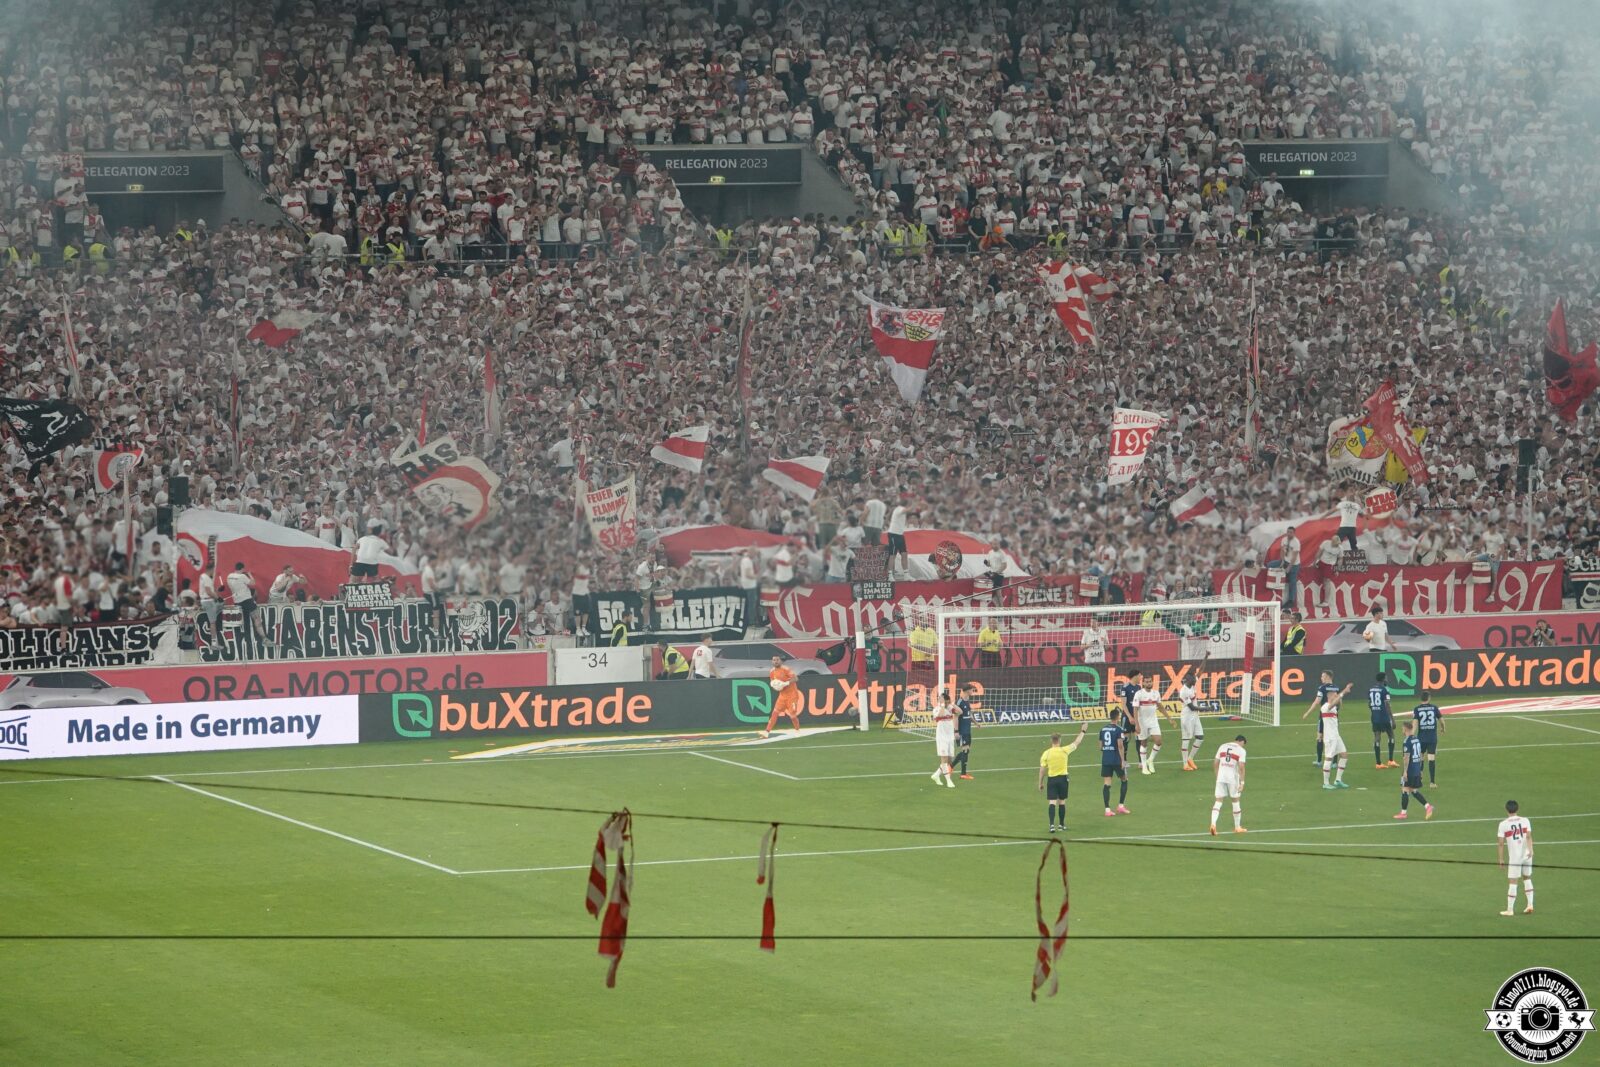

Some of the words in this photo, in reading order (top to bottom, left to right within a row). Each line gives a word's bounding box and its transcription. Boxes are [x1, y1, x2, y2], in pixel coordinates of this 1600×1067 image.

[665, 159, 737, 169] RELEGATION
[740, 158, 768, 168] 2023
[1260, 152, 1328, 162] RELEGATION
[1330, 151, 1357, 162] 2023
[84, 166, 158, 177] RELEGATION
[160, 165, 190, 176] 2023
[587, 489, 613, 504] FEUER
[346, 583, 391, 596] ULTRAS
[1498, 563, 1556, 612] 97
[347, 600, 394, 608] WIDERSTAND
[183, 664, 485, 702] ORA-MOTOR.de
[1369, 691, 1382, 707] 18
[440, 687, 652, 732] buXtrade
[1418, 711, 1435, 726] 23
[67, 716, 148, 743] Made
[156, 714, 182, 739] in
[190, 713, 322, 740] Germany
[1104, 731, 1112, 746] 9
